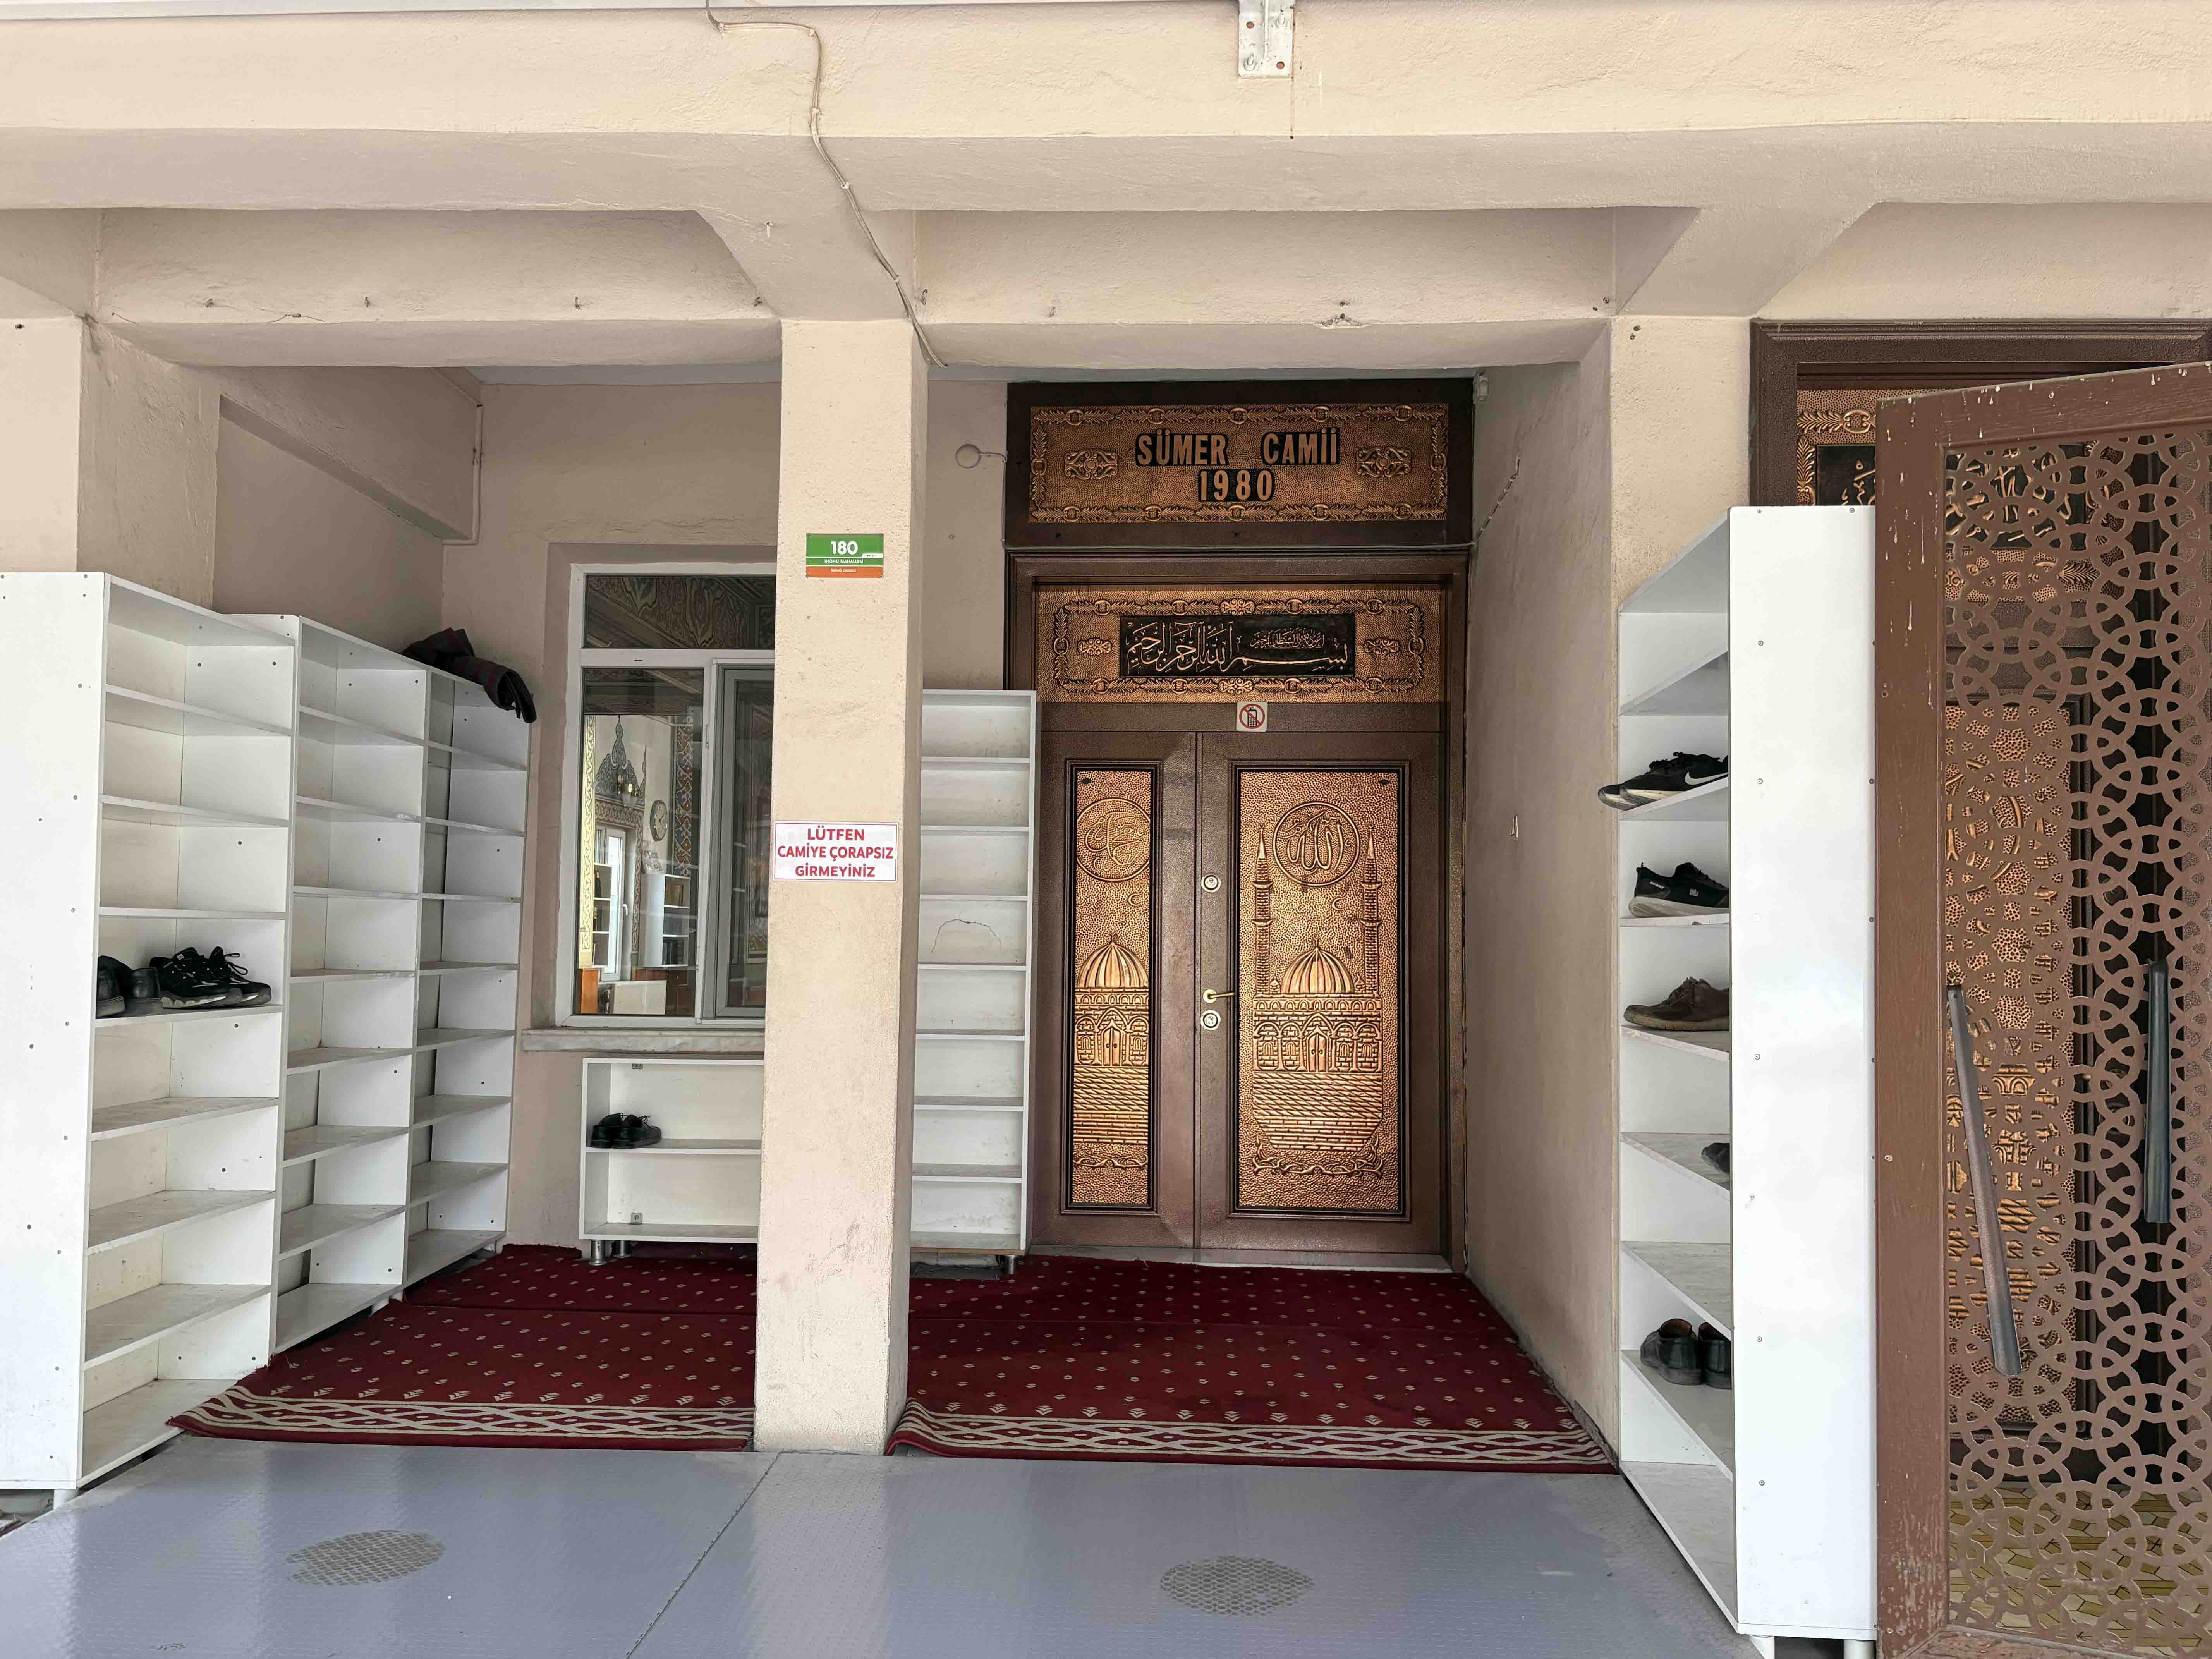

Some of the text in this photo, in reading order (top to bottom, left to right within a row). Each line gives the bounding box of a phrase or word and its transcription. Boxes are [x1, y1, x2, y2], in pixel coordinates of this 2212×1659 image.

[1137, 428, 1337, 465] SÜMER CAMİİ
[1200, 470, 1273, 501] 1980
[831, 541, 858, 555] 180
[807, 825, 865, 841] LÜTFEN
[778, 842, 894, 862] CAMİYE ÇORAPSIZ
[795, 863, 876, 877] GİRMEYİNİZ
